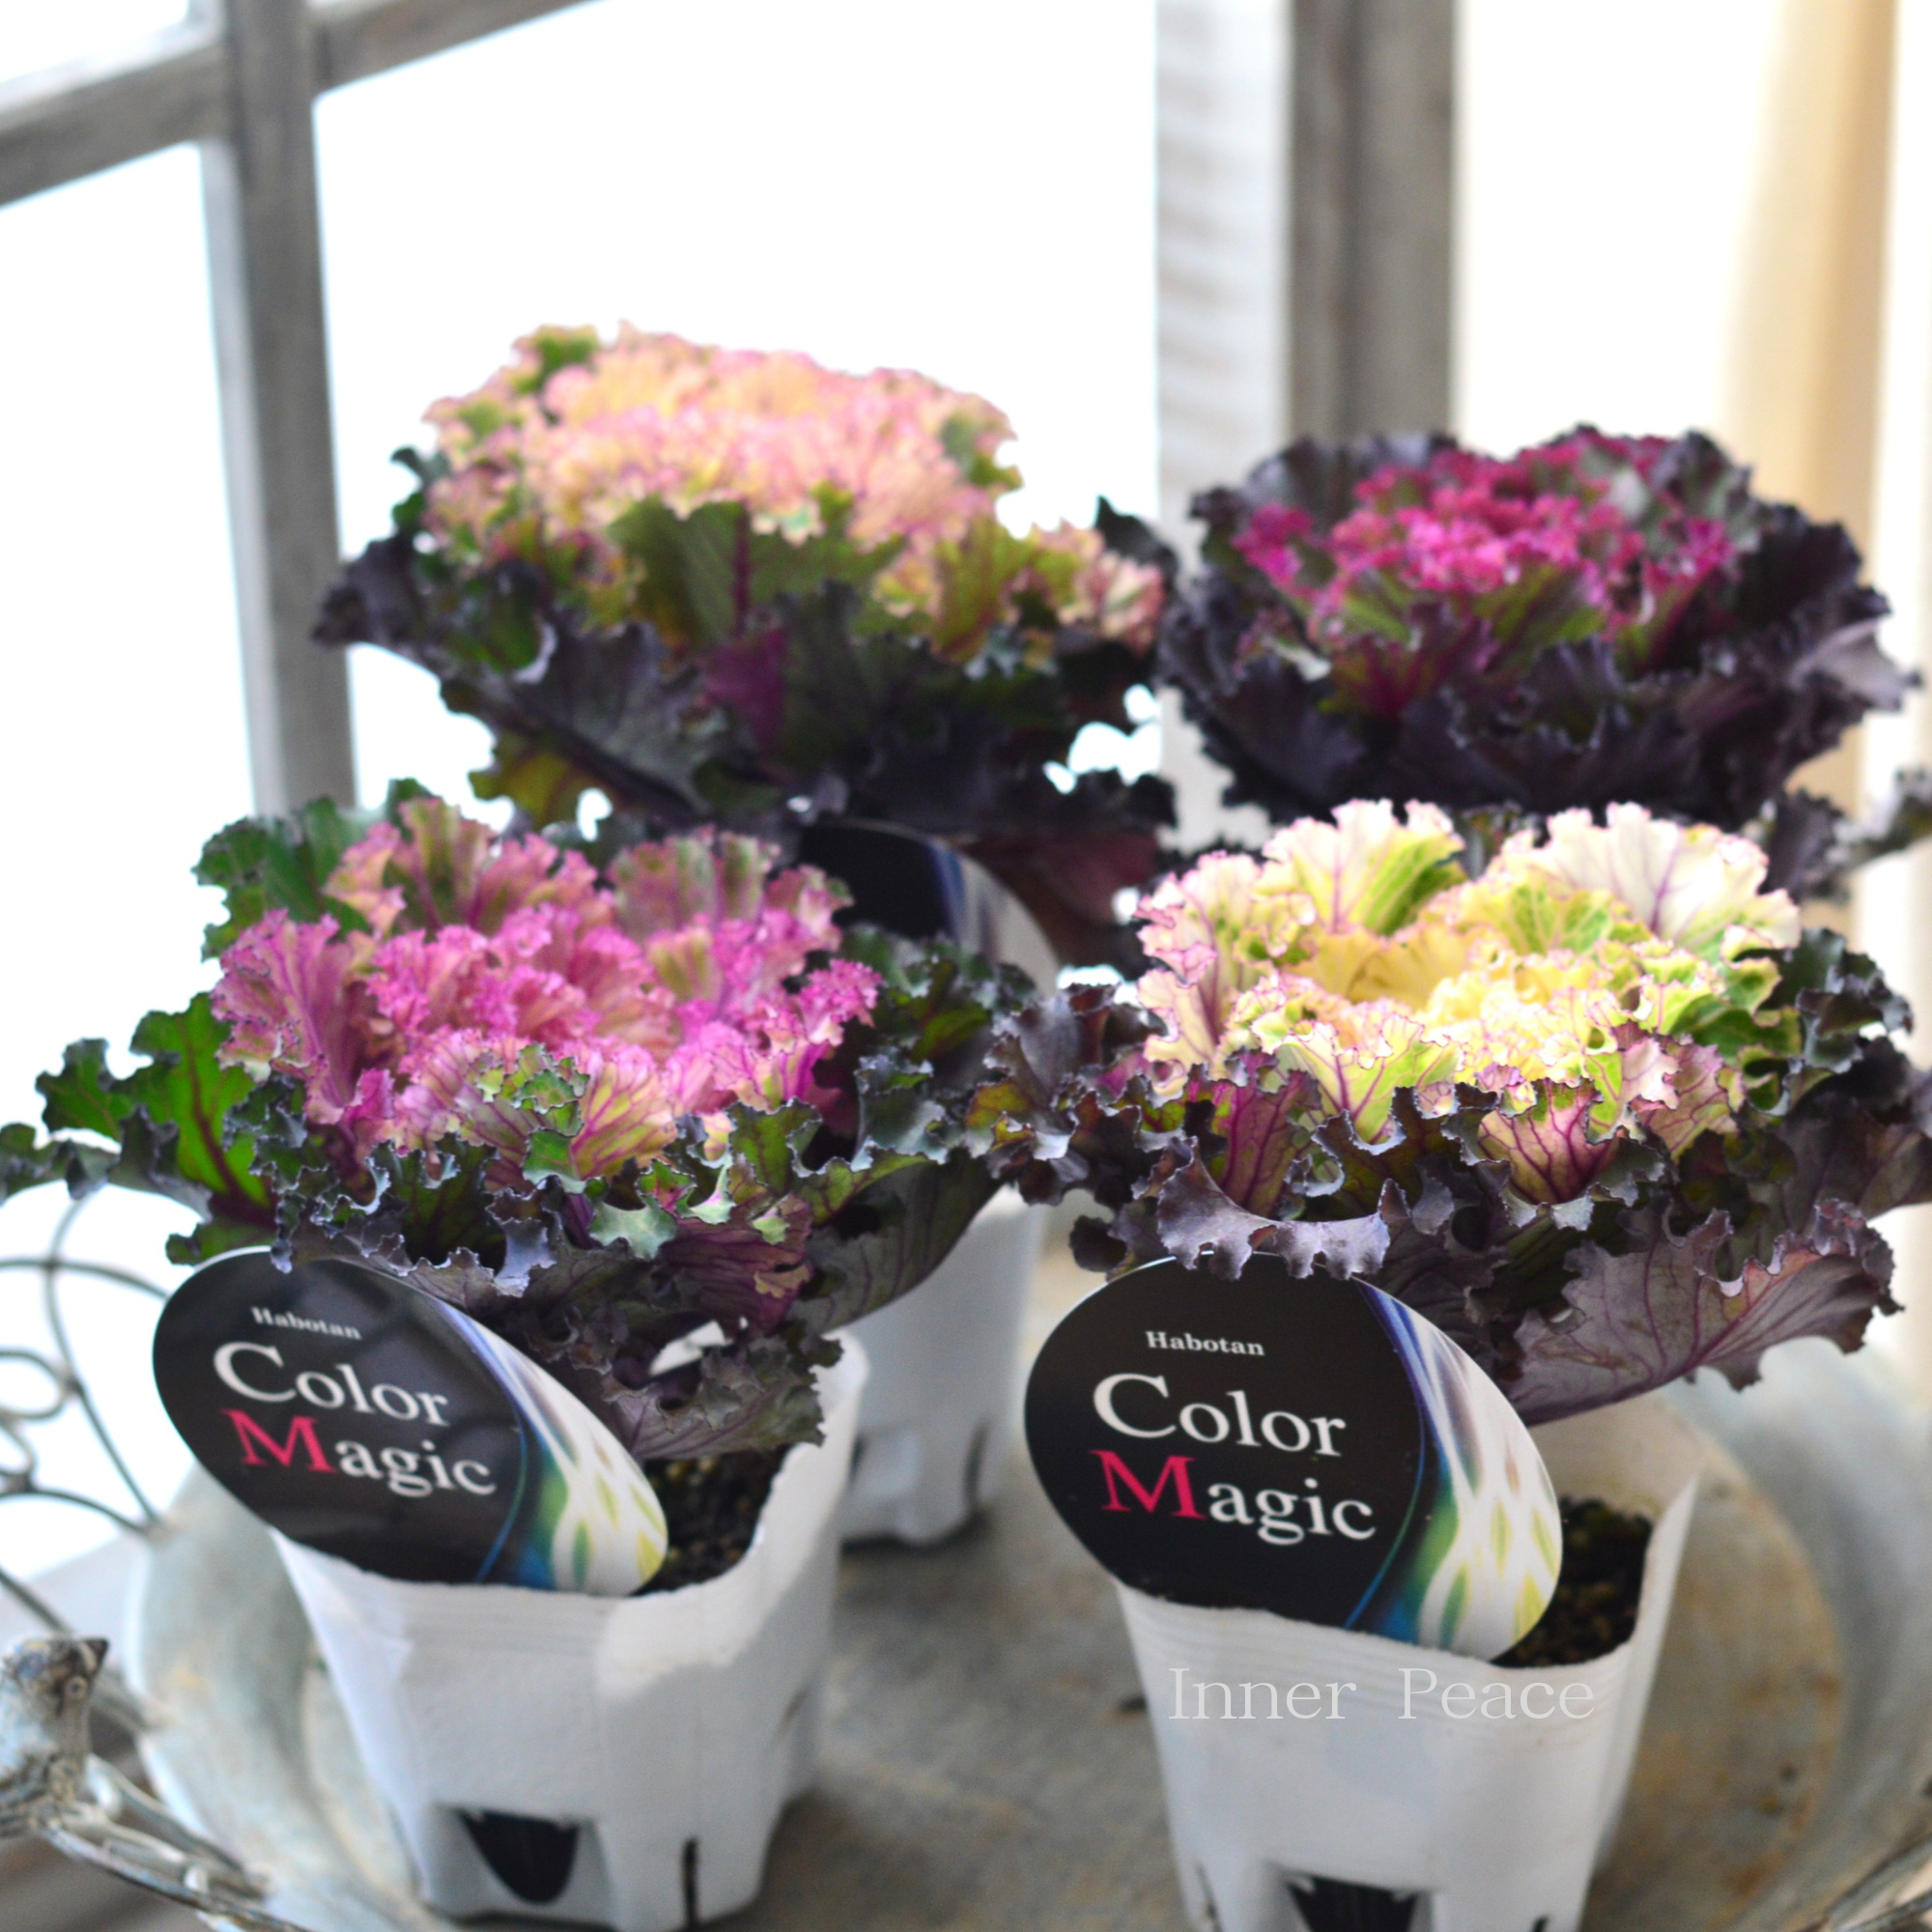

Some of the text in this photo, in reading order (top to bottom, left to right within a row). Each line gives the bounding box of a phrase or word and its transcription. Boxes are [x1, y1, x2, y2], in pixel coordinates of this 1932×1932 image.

[251, 1306, 362, 1340] Habotan
[1145, 1329, 1266, 1357] Habotan
[213, 1342, 448, 1426] Color
[1093, 1372, 1347, 1458] Color
[221, 1409, 497, 1497] Magic
[1093, 1450, 1377, 1546] Magic
